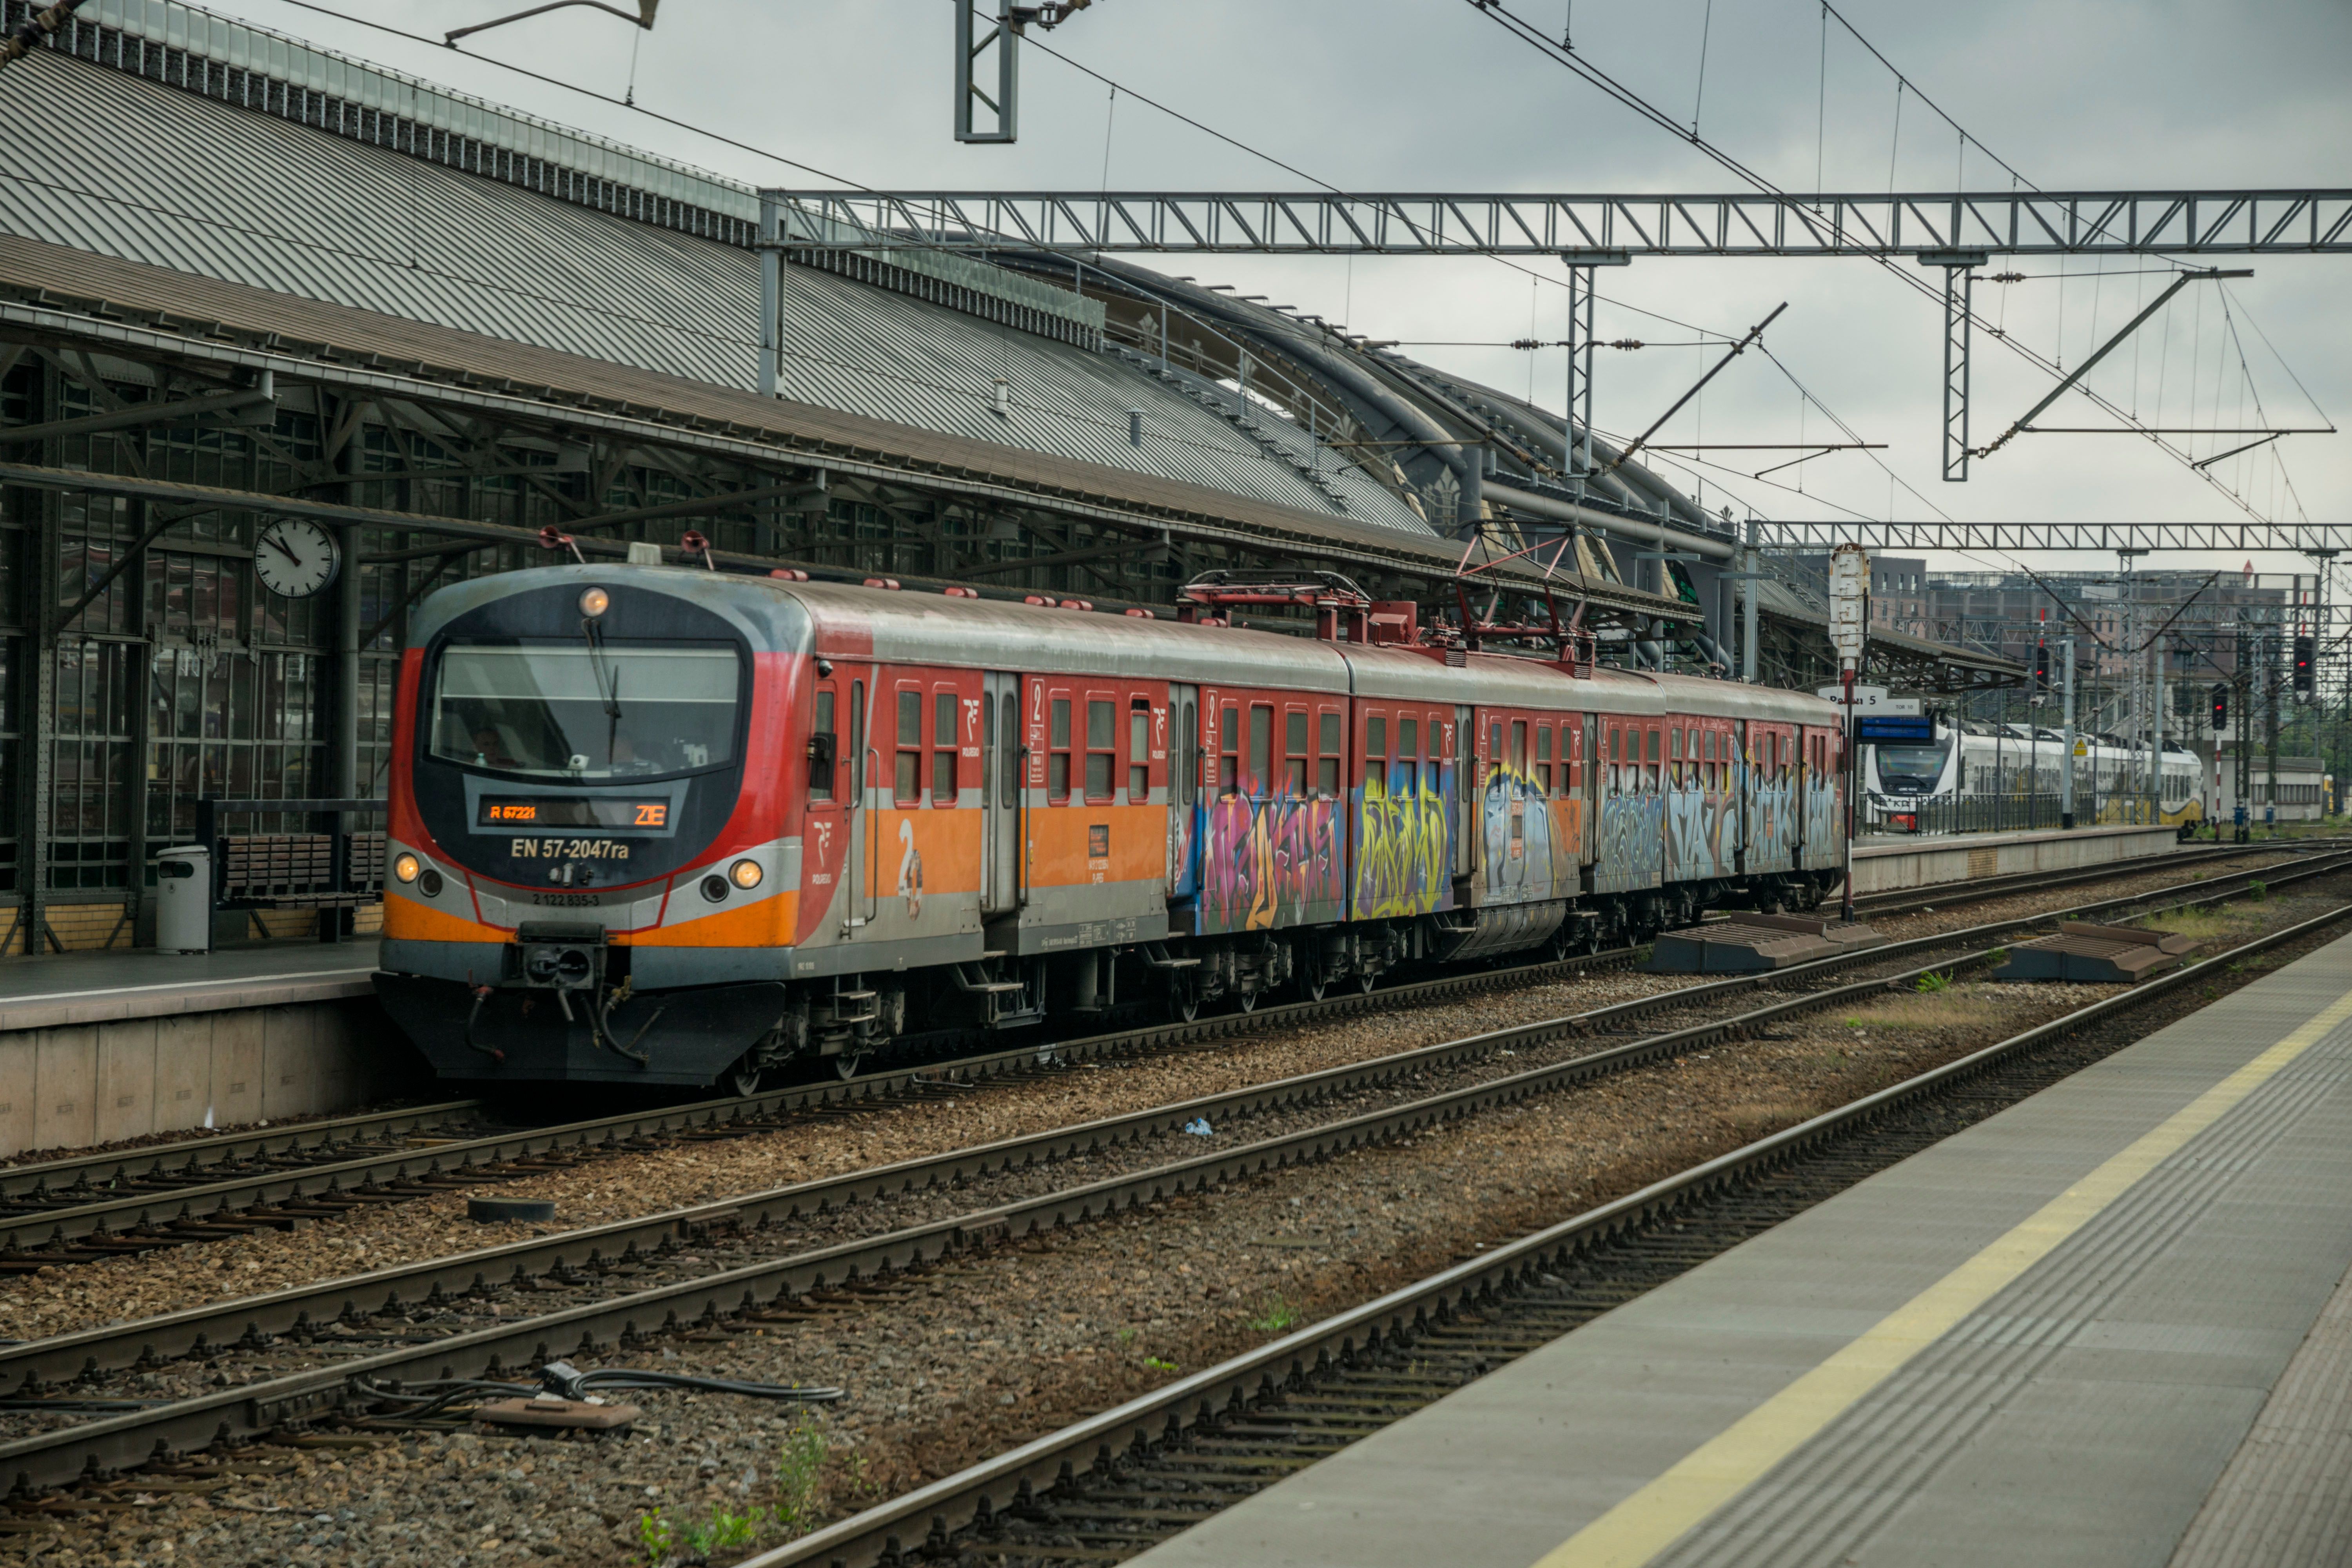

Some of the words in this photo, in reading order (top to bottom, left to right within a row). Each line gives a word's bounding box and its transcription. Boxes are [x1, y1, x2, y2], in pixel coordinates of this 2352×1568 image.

[1034, 684, 1041, 721] 2
[1869, 696, 1876, 705] 5
[1209, 695, 1214, 728] 2
[490, 806, 501, 818] R
[511, 838, 538, 857] EN
[542, 839, 629, 859] 57-2047ra
[533, 894, 540, 905] 2
[544, 894, 564, 906] 122
[568, 894, 599, 907] 835-3
